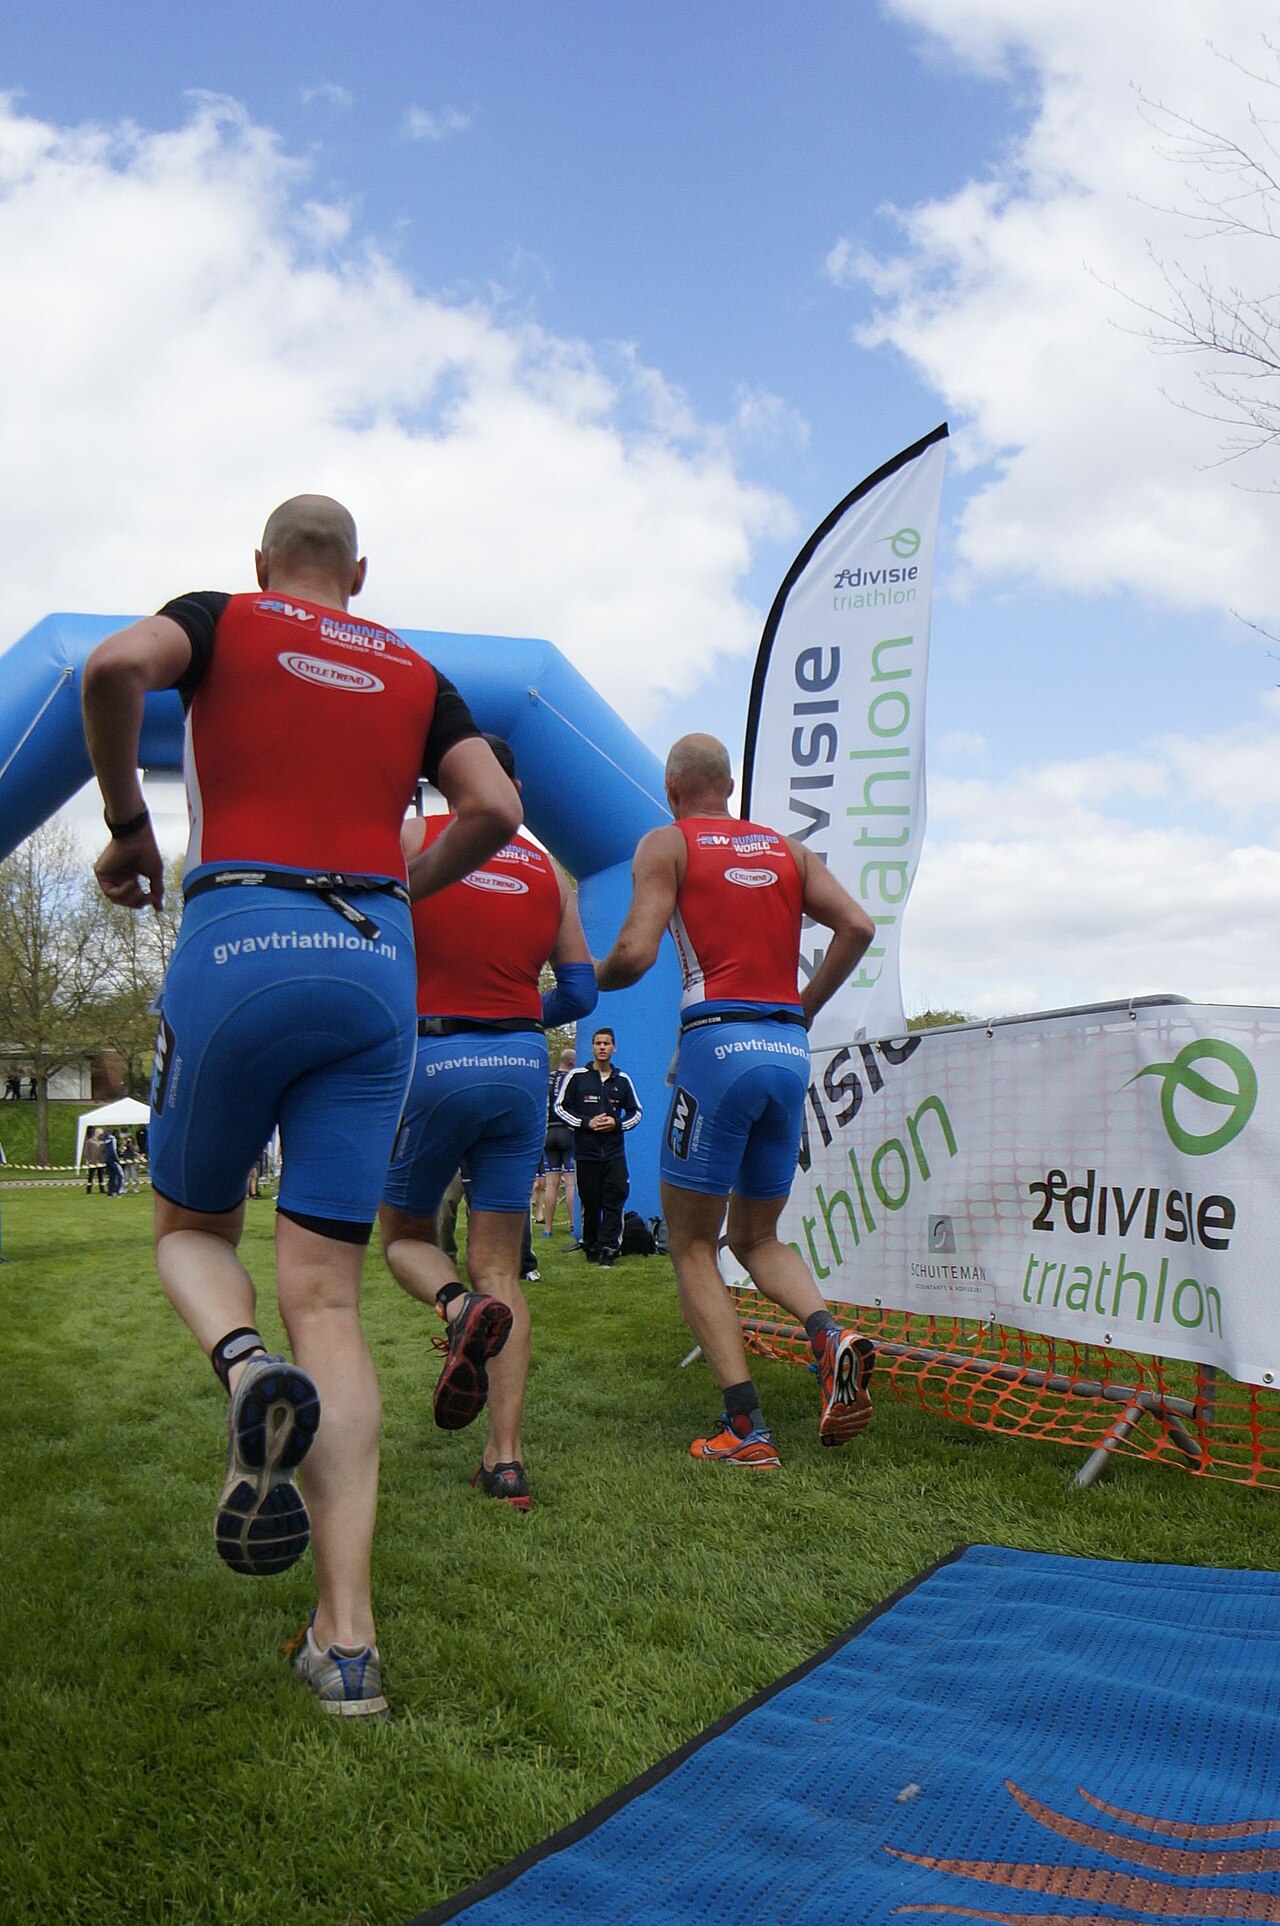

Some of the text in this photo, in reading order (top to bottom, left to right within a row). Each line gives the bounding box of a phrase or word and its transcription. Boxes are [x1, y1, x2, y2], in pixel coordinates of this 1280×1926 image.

[833, 587, 917, 611] triathlon
[320, 625, 386, 651] WORLD
[321, 617, 406, 649] RUNNERS
[731, 833, 780, 845] RUNNERS
[733, 841, 771, 853] WORLD
[495, 850, 529, 863] ORLD
[213, 931, 397, 965] gvavtriathlon.nl
[714, 1039, 810, 1060] gvavtriathlon.
[426, 1055, 541, 1077] gvavtriathlon.nl
[911, 1263, 986, 1280] SCHUITEMAN
[1022, 1253, 1223, 1340] triathlon
